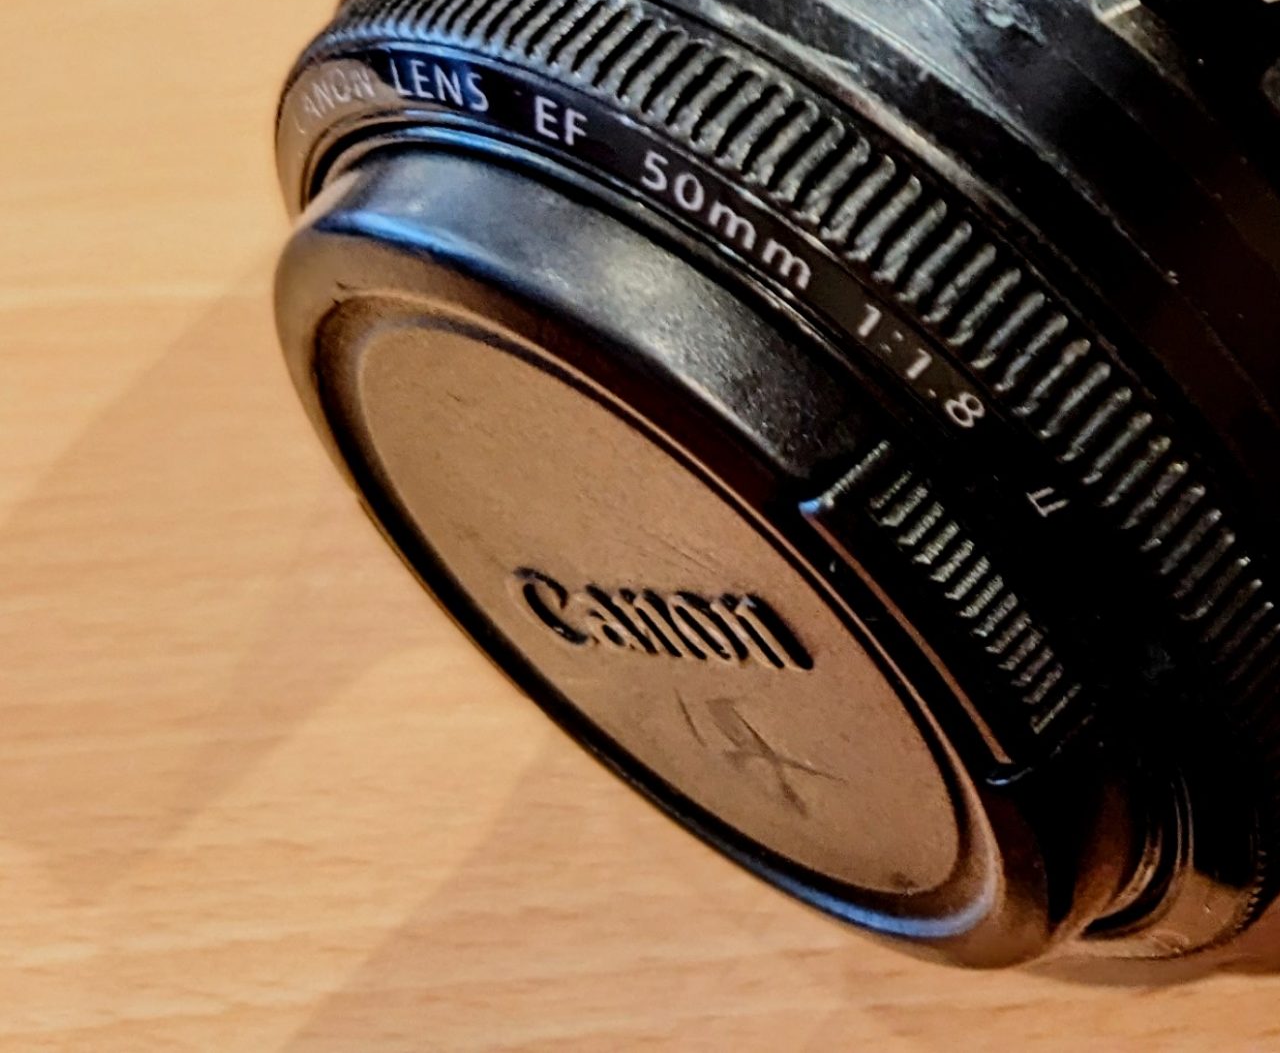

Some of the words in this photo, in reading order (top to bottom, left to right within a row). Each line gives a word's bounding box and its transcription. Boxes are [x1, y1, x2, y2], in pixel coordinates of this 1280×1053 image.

[389, 57, 490, 112] LENS
[534, 94, 588, 146] EF
[640, 150, 812, 290] 50mm
[857, 302, 987, 430] 1:1.8
[505, 564, 815, 671] Canon
